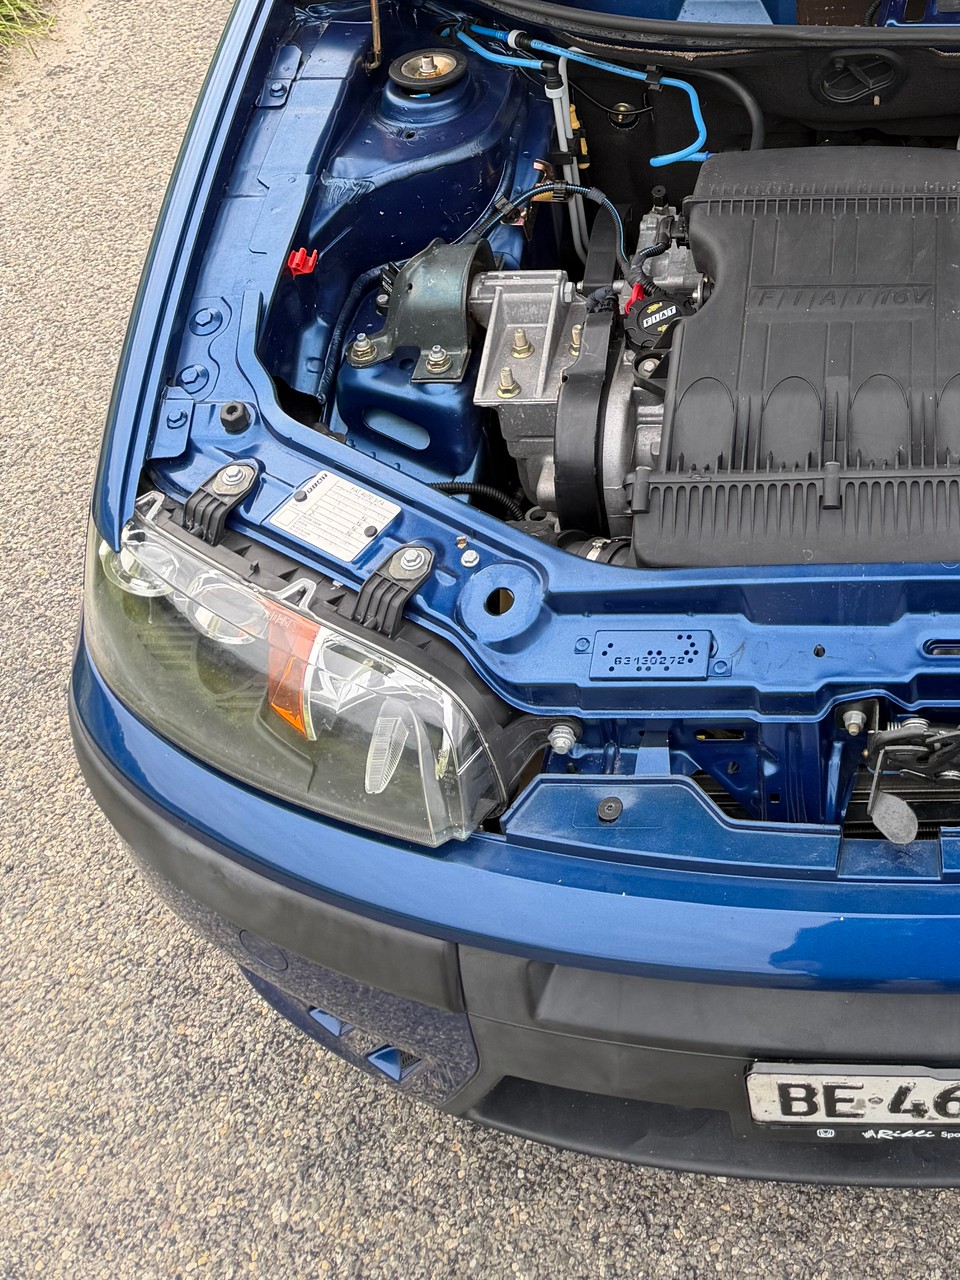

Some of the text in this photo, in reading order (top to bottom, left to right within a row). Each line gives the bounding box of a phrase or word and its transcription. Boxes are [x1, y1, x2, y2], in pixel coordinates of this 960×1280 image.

[880, 287, 933, 306] 16V
[643, 306, 677, 328] FIAT
[614, 656, 685, 665] 63130272
[776, 1081, 865, 1119] BE
[876, 1128, 936, 1140] Rikli
